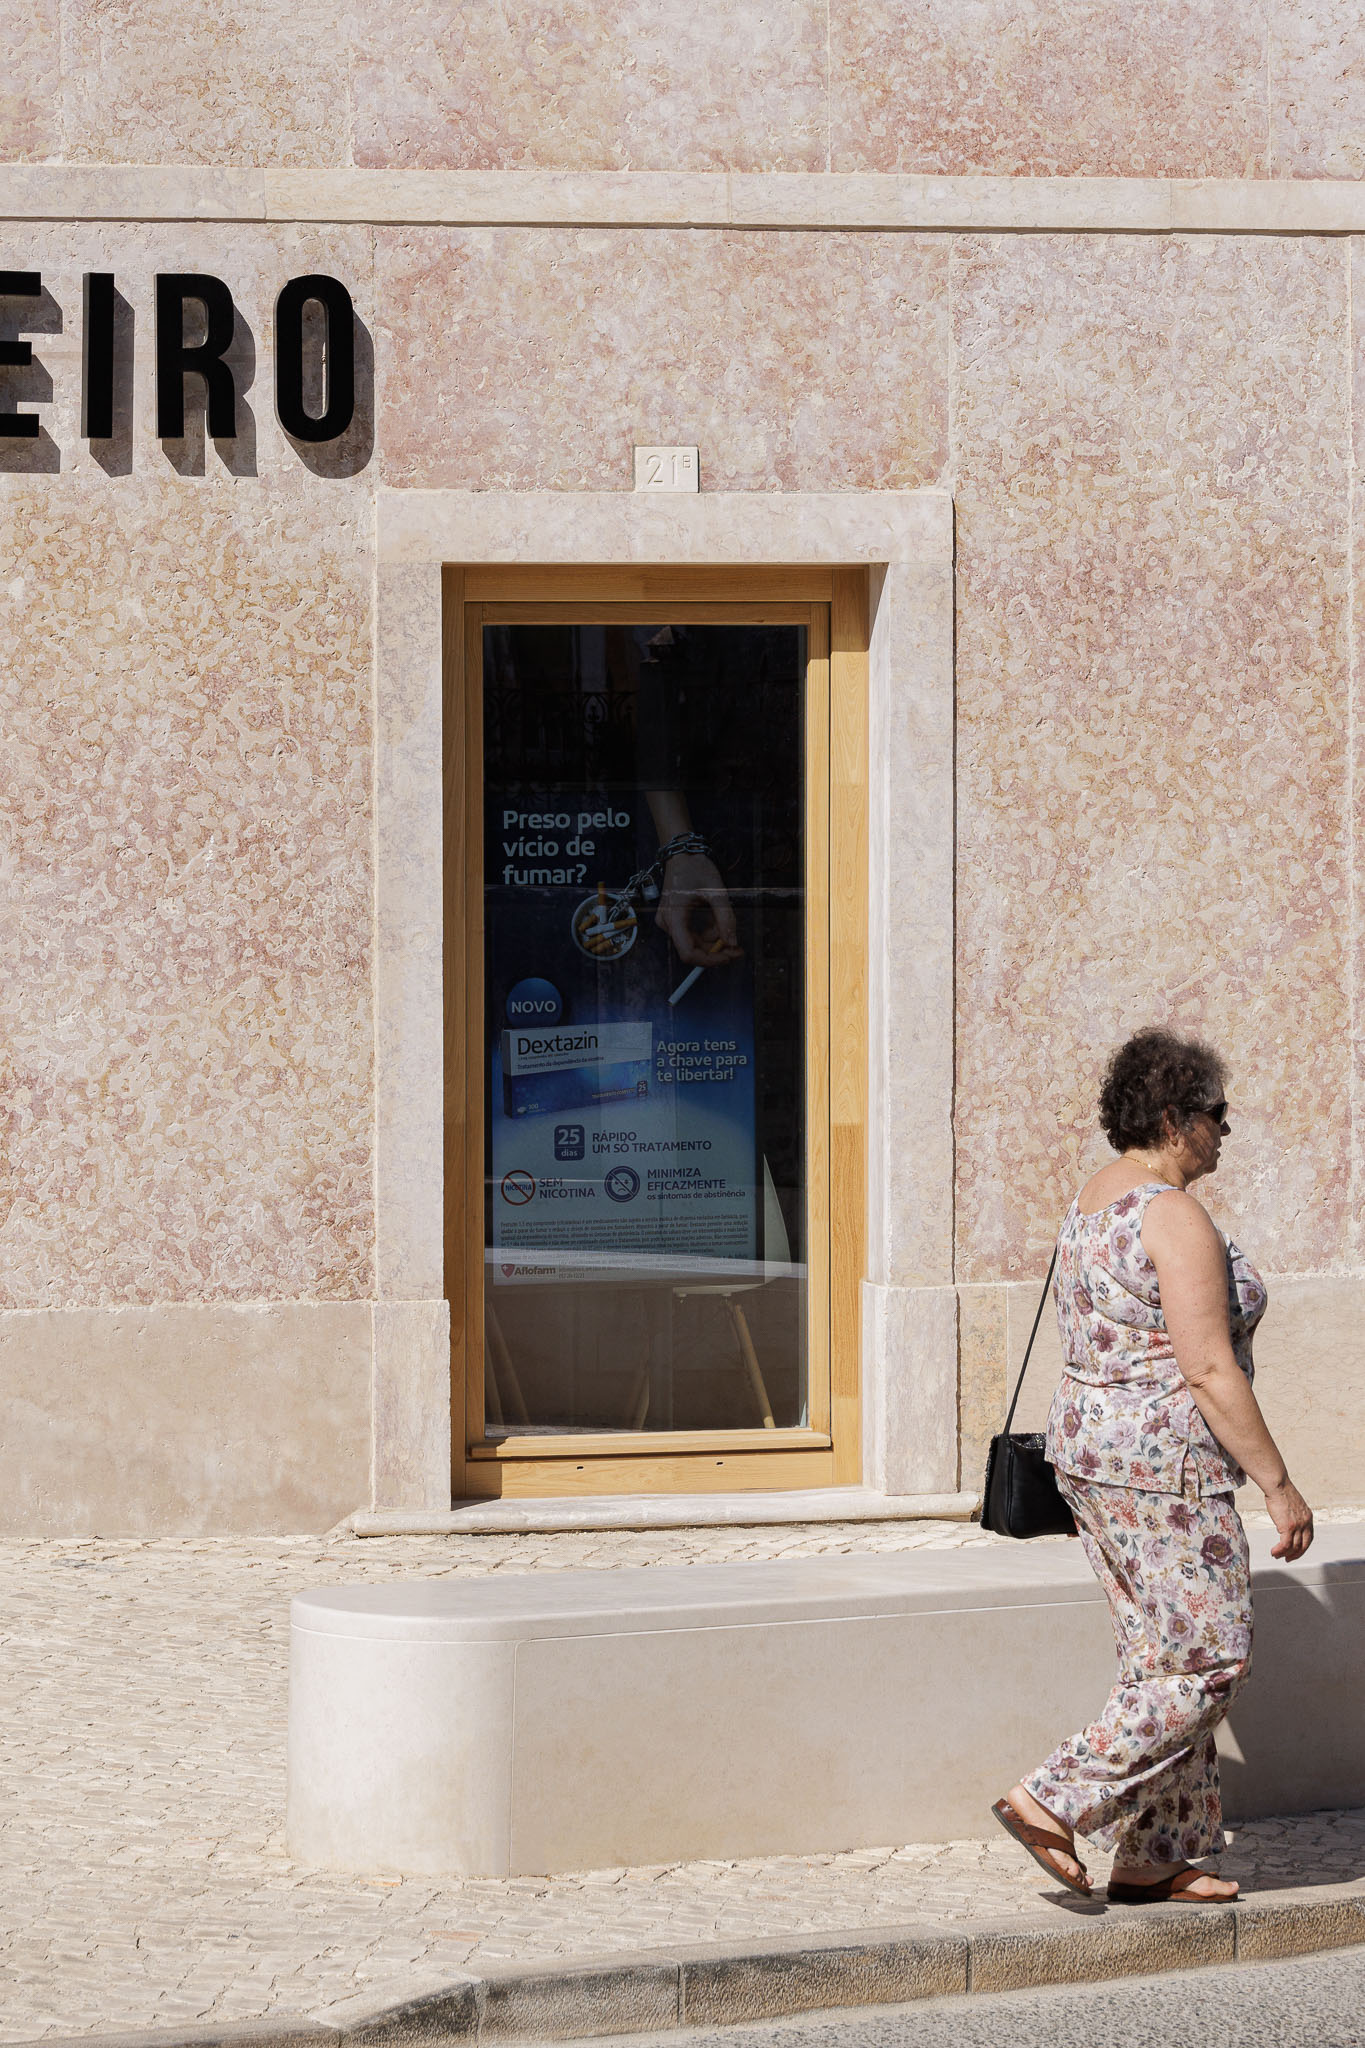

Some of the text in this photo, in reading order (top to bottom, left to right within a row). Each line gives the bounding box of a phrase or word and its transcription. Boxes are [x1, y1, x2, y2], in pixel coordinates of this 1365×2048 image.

[503, 808, 630, 834] Preso pelo
[503, 836, 595, 857] vício de
[502, 864, 588, 885] fumar?
[511, 1000, 557, 1014] NOVO
[517, 1031, 599, 1056] Dextazin
[656, 1039, 736, 1056] Agora tens
[656, 1055, 747, 1068] a chave para
[656, 1067, 734, 1082] te libertar!
[558, 1128, 580, 1145] 25
[592, 1130, 637, 1142] RÁPIDO
[561, 1148, 578, 1157] dias
[592, 1140, 712, 1153] UM SÓ TRATAMENTO
[647, 1168, 701, 1178] MINIMIZA
[539, 1178, 563, 1187] SEM
[647, 1179, 726, 1191] EFICAZMENTE
[539, 1187, 596, 1199] NICOTINA
[657, 1191, 692, 1200] sintomas
[693, 1190, 703, 1198] de
[704, 1189, 746, 1199] abstinência
[514, 1265, 556, 1276] Aflofarm
